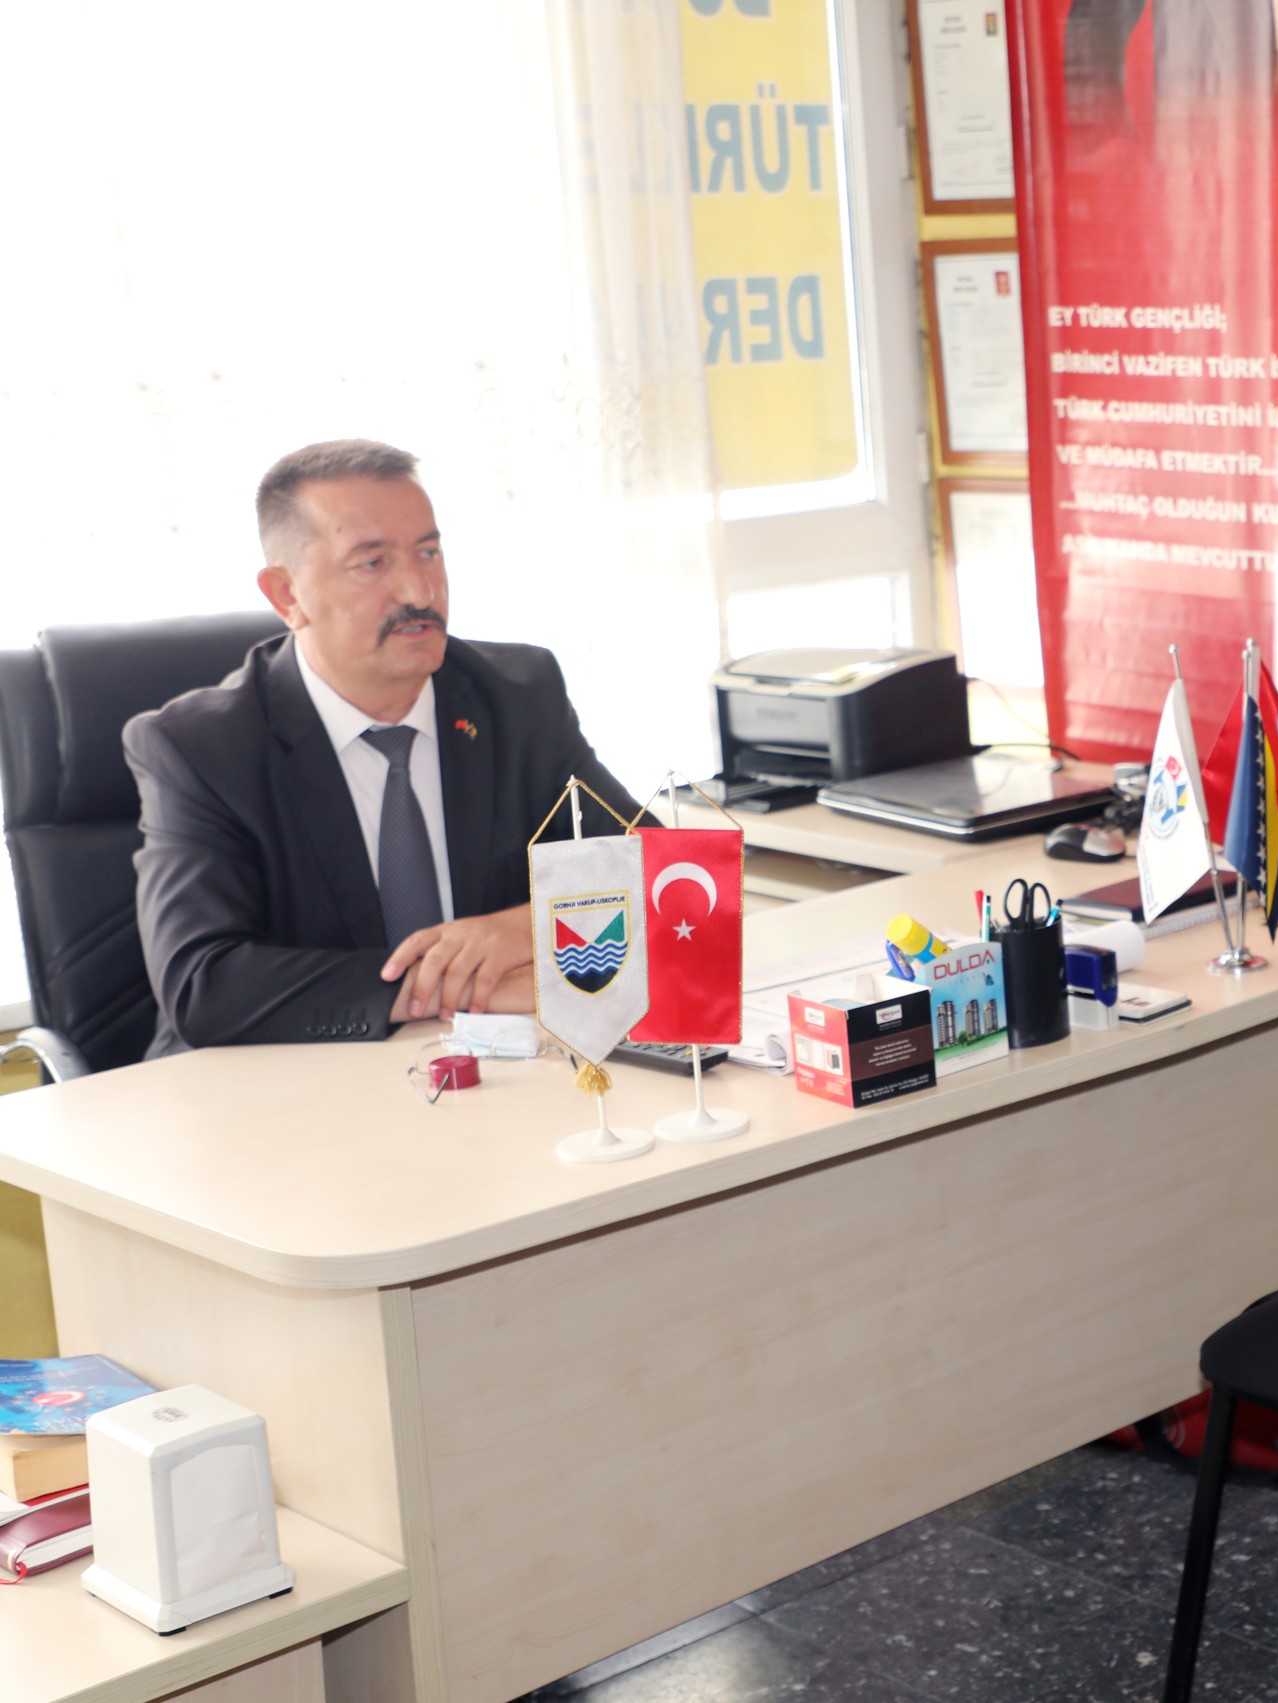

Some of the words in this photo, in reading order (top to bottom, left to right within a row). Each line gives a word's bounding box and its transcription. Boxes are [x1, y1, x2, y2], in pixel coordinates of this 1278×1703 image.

[1048, 306, 1074, 328] EY
[1077, 303, 1128, 328] TÜRK
[1131, 304, 1228, 334] GENÇLİĞİ;
[1051, 349, 1120, 375] BİRİNCİ
[1124, 351, 1203, 379] VAZİFEN
[1206, 353, 1266, 380] TÜRK
[1053, 395, 1105, 420] TÜRK
[1106, 398, 1263, 428] CUMHURİYETİNİ
[1055, 444, 1082, 466] VE
[1152, 496, 1247, 523] OLDUĞUN
[933, 949, 996, 980] DULDA
